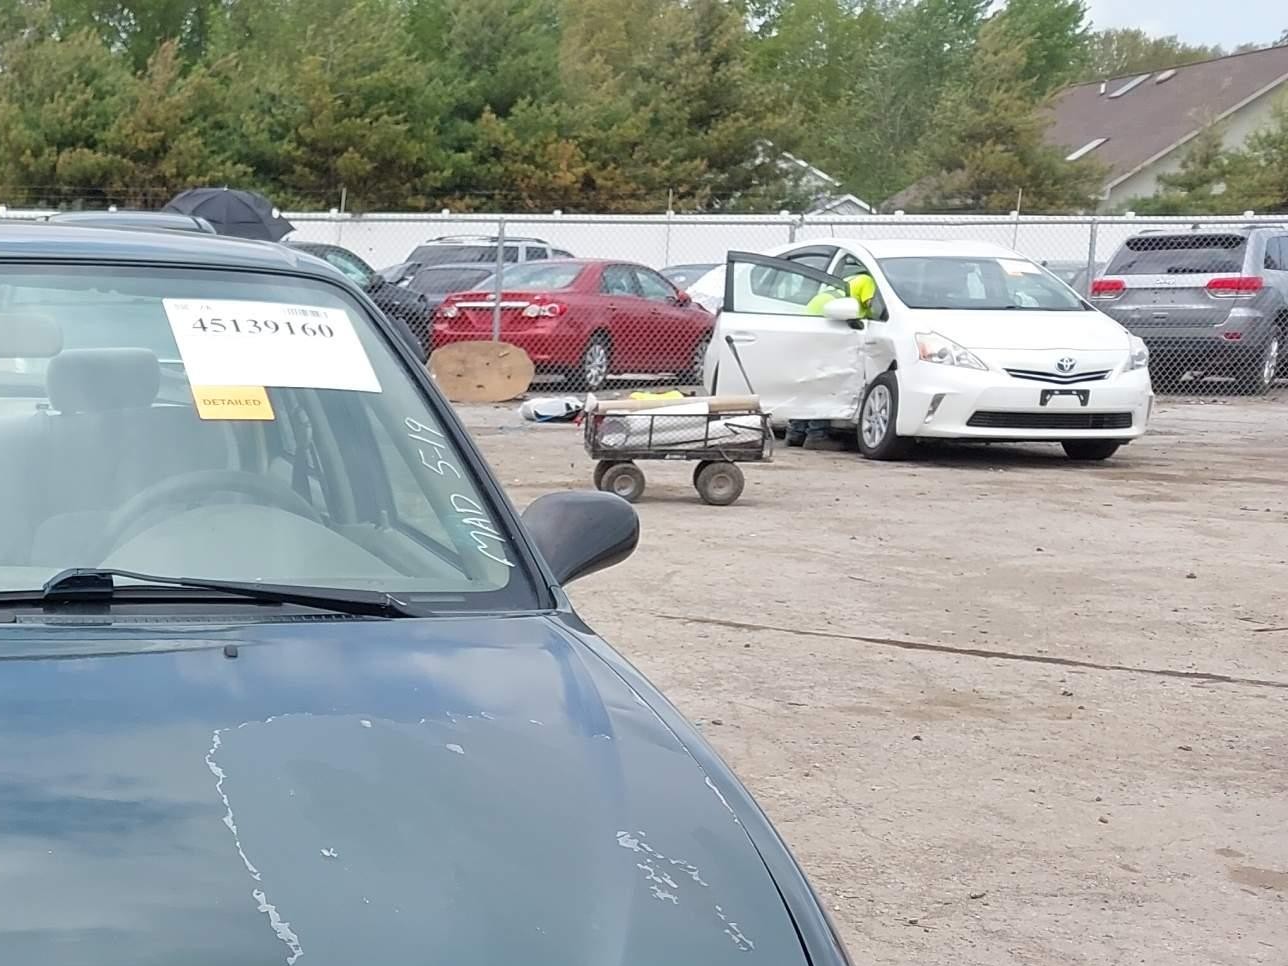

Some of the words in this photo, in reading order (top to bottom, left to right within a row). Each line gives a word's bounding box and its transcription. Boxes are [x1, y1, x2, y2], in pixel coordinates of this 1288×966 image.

[192, 316, 335, 339] 45139160
[202, 398, 263, 407] DETAILED
[404, 417, 462, 479] 5-19
